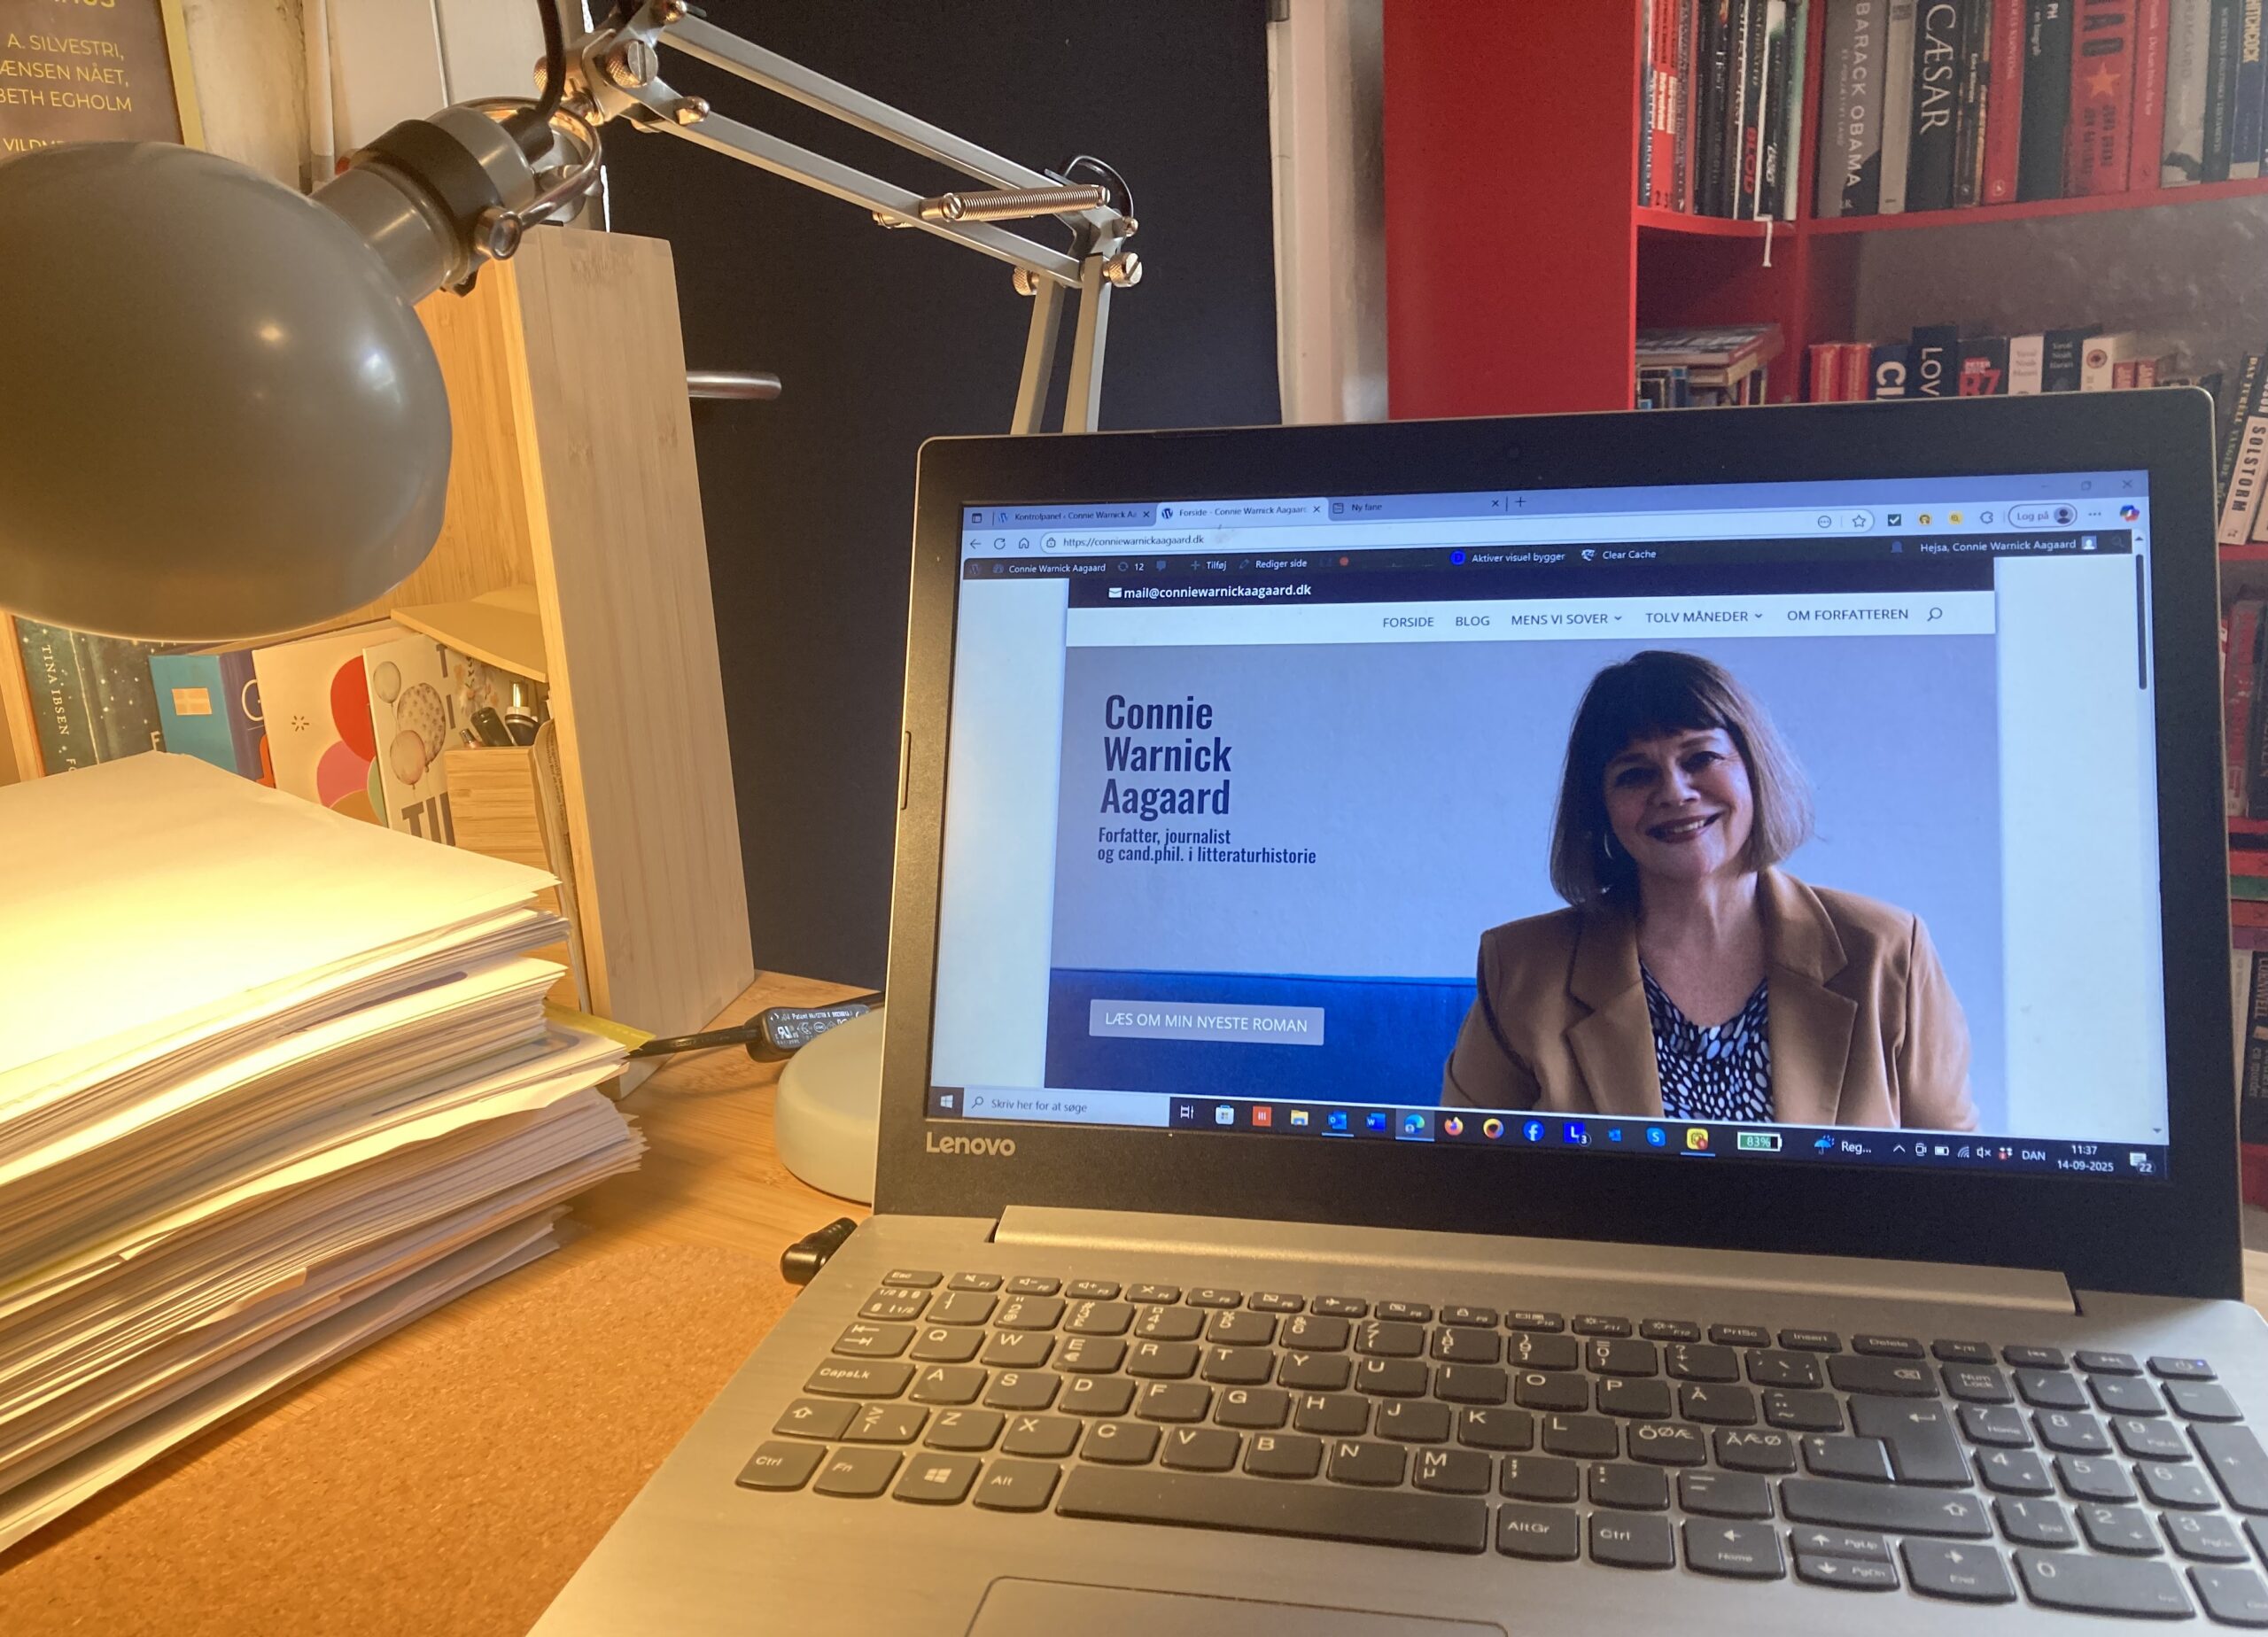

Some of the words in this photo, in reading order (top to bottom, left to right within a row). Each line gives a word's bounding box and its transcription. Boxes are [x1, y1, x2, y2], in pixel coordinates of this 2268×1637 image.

[7, 33, 26, 50] A.
[29, 35, 124, 61] SILVESTRI,
[1851, 3, 1870, 96] BARACK
[76, 62, 129, 87] NÅET,
[1920, 4, 1956, 135] CÆSAR
[50, 91, 132, 112] EGHOLM
[1846, 105, 1866, 187] OBAMA
[1744, 127, 1758, 194] BLOD
[2232, 426, 2265, 512] SOLSTORM
[1179, 508, 1208, 517] Forside
[1215, 508, 1241, 516] Connie
[1243, 506, 1275, 516] Warnick
[1351, 503, 1363, 512] Ny
[1364, 502, 1382, 511] fane
[1015, 511, 1061, 522] Kontrolpanel
[1068, 511, 1094, 520] Connie
[1096, 510, 1126, 520] Warnick
[2016, 511, 2035, 523] Log
[2037, 510, 2049, 522] på
[1063, 534, 1205, 548] https://conniewarnickaagaard.dk
[1920, 543, 1950, 554] Hejsa,
[1952, 541, 1988, 552] Connie
[1990, 540, 2031, 551] Warnick
[2033, 539, 2077, 552] Aagaard
[1472, 554, 1503, 563] Aktiver
[1505, 553, 1531, 562] visuel
[1533, 552, 1565, 563] bygger
[1602, 550, 1627, 560] Clear
[1627, 549, 1657, 560] Cache
[1009, 564, 1037, 574] Connie
[1038, 563, 1070, 574] Warnick
[1073, 562, 1106, 575] Aagaard
[1206, 561, 1227, 572] Tilføj
[1255, 559, 1288, 570] Rediger
[1290, 559, 1308, 568] side
[1123, 584, 1312, 599] mail@conniewarnickaagaard.dk
[1456, 616, 1490, 627] BLOG
[1511, 615, 1548, 625] MENS
[1550, 615, 1563, 625] VI
[1566, 613, 1608, 625] SOVER
[1645, 612, 1680, 624] TOLV
[1683, 609, 1748, 623] MÅNEDER
[1787, 609, 1810, 621] OM
[1814, 609, 1909, 621] FORFATTEREN
[1383, 617, 1434, 628] FORSIDE
[42, 644, 58, 685] TINA
[50, 688, 70, 736] IBSEN
[1105, 694, 1213, 730] Connie
[1104, 736, 1232, 772] Warnick
[1100, 778, 1230, 822] Aagaard
[1099, 826, 1161, 845] Forfatter,
[1164, 828, 1231, 845] journalist
[1098, 848, 1115, 864] og
[1118, 846, 1184, 865] cand.phil.
[1188, 847, 1193, 862] i
[1197, 847, 1317, 864] litteraturhistorie
[1105, 1012, 1133, 1027] LÆS
[1137, 1013, 1161, 1028] OM
[1165, 1014, 1192, 1028] MIN
[1197, 1015, 1249, 1030] NYESTE
[1252, 1017, 1309, 1033] ROMAN
[990, 1098, 1014, 1110] Skriv
[1017, 1098, 1034, 1111] her
[1036, 1099, 1049, 1111] for
[1052, 1101, 1061, 1112] at
[1063, 1102, 1088, 1115] søge
[925, 1131, 1016, 1157] Lenovo
[1581, 1135, 1588, 1144] 3
[1746, 1137, 1771, 1148] 83%
[1841, 1141, 1871, 1153] Reg...
[2071, 1144, 2098, 1155] 11:37
[2022, 1150, 2046, 1161] DAN
[2057, 1160, 2115, 1172] 14-09-2025
[2139, 1162, 2153, 1173] 22
[928, 1330, 947, 1342] Q
[1000, 1333, 1023, 1346] W
[1793, 1333, 1828, 1342] Insert
[1869, 1338, 1909, 1347] Delete
[1068, 1338, 1085, 1351] E
[1140, 1344, 1159, 1356] R
[1217, 1348, 1233, 1361] T
[1293, 1354, 1309, 1366] Y
[820, 1367, 870, 1379] CapsLk
[1368, 1361, 1385, 1372] U
[927, 1369, 944, 1381] A
[1001, 1374, 1019, 1386] S
[1526, 1374, 1546, 1385] O
[1074, 1378, 1093, 1392] D
[1150, 1385, 1168, 1396] F
[1606, 1379, 1622, 1392] P
[1963, 1380, 1993, 1390] Lock
[1228, 1391, 1247, 1403] G
[1306, 1396, 1325, 1410] H
[1387, 1403, 1402, 1416] J
[1972, 1408, 1989, 1420] 7
[941, 1413, 961, 1425] Z
[1469, 1410, 1487, 1424] K
[2050, 1415, 2068, 1427] 8
[1019, 1418, 1039, 1432] X
[1553, 1417, 1568, 1431] L
[2128, 1421, 2146, 1433] 9
[1097, 1424, 1116, 1438] C
[1178, 1431, 1196, 1444] V
[1257, 1437, 1275, 1450] B
[1340, 1445, 1360, 1457] N
[756, 1455, 782, 1467] Ctrl
[1425, 1453, 1448, 1467] M
[1992, 1453, 2008, 1466] 4
[832, 1462, 853, 1472] Fn
[2073, 1461, 2091, 1474] 5
[2155, 1467, 2173, 1480] 6
[990, 1476, 1013, 1486] Alt
[2015, 1503, 2027, 1517] 1
[2094, 1510, 2116, 1525] 2
[1508, 1521, 1550, 1534] AltGr
[2179, 1517, 2201, 1532] 3
[1600, 1529, 1631, 1540] Ctrl
[1845, 1539, 1877, 1550] PgUp
[1718, 1552, 1753, 1563] Home
[1852, 1566, 1886, 1578] PgDn
[2037, 1562, 2056, 1578] 0
[1950, 1575, 1976, 1586] End
